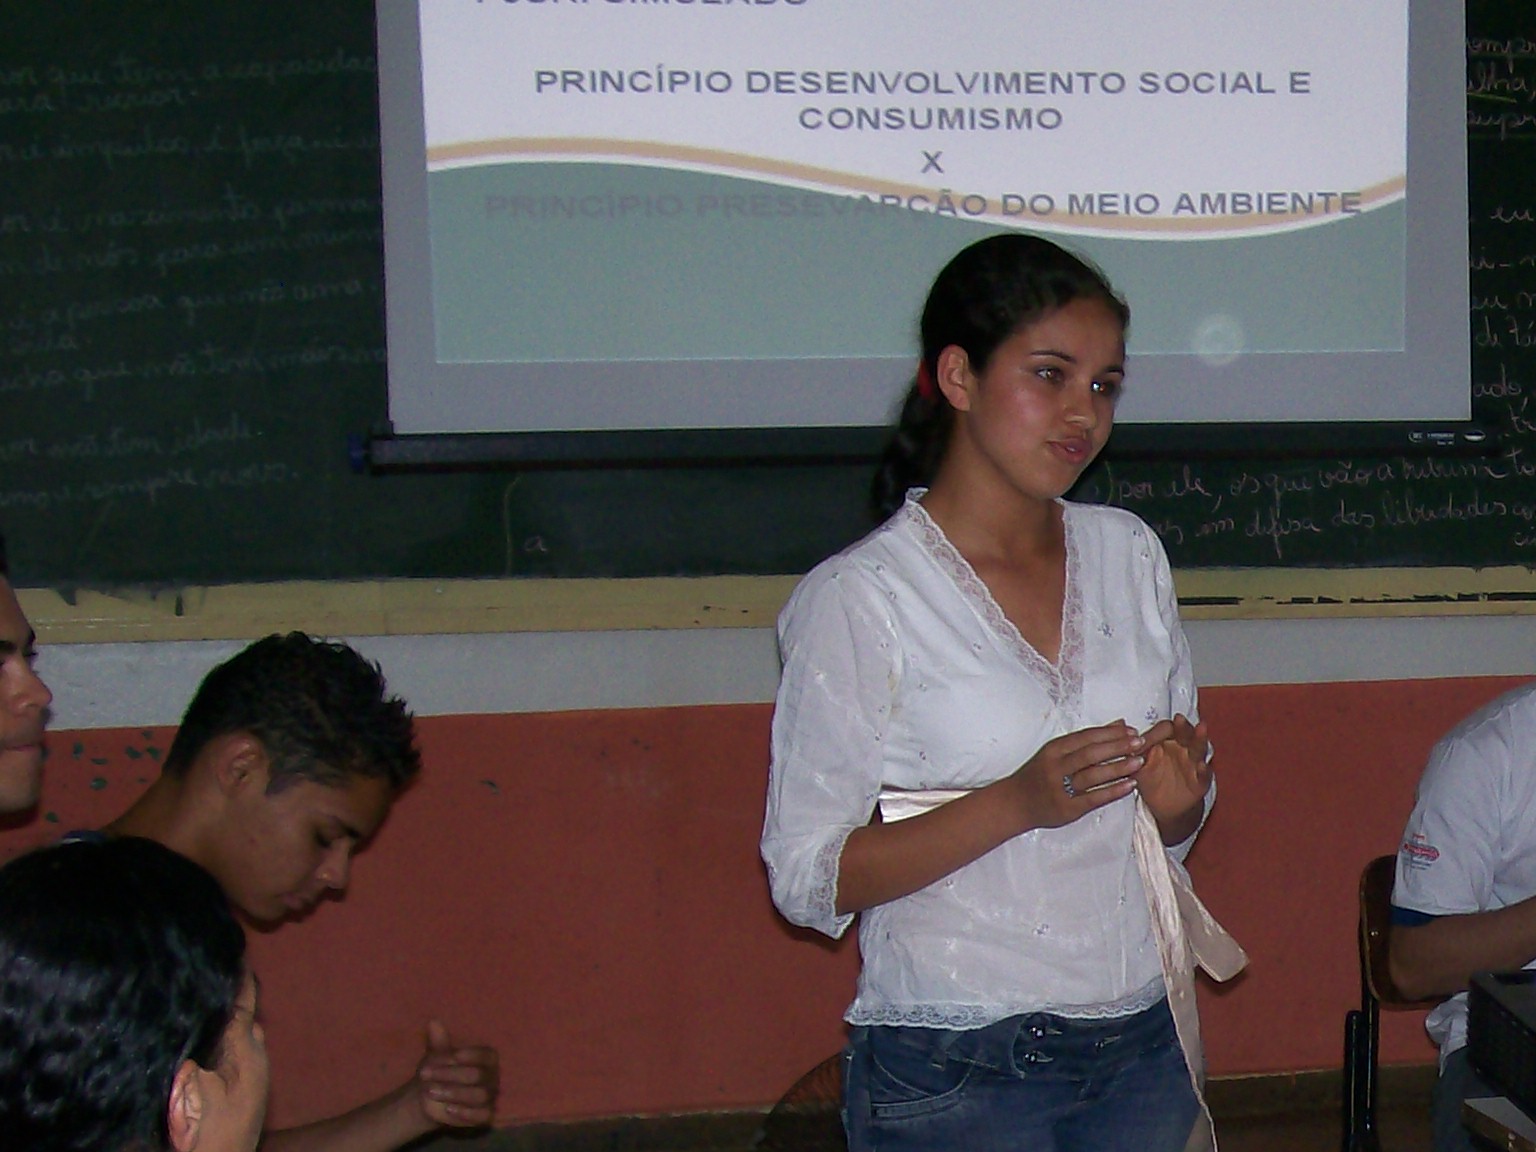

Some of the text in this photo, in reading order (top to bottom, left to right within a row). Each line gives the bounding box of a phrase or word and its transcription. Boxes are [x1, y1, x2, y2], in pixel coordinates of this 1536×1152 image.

[534, 64, 1312, 94] PRINCÍPIO DESENVOLVIMENTO SOCIAL E
[799, 107, 1063, 130] CONSUMISMO
[921, 151, 944, 173] X
[483, 189, 682, 220] PRINCÍPIO
[1002, 193, 1055, 216] DO
[1068, 193, 1160, 215] MEIO
[1172, 192, 1362, 215] AMBIENTE
